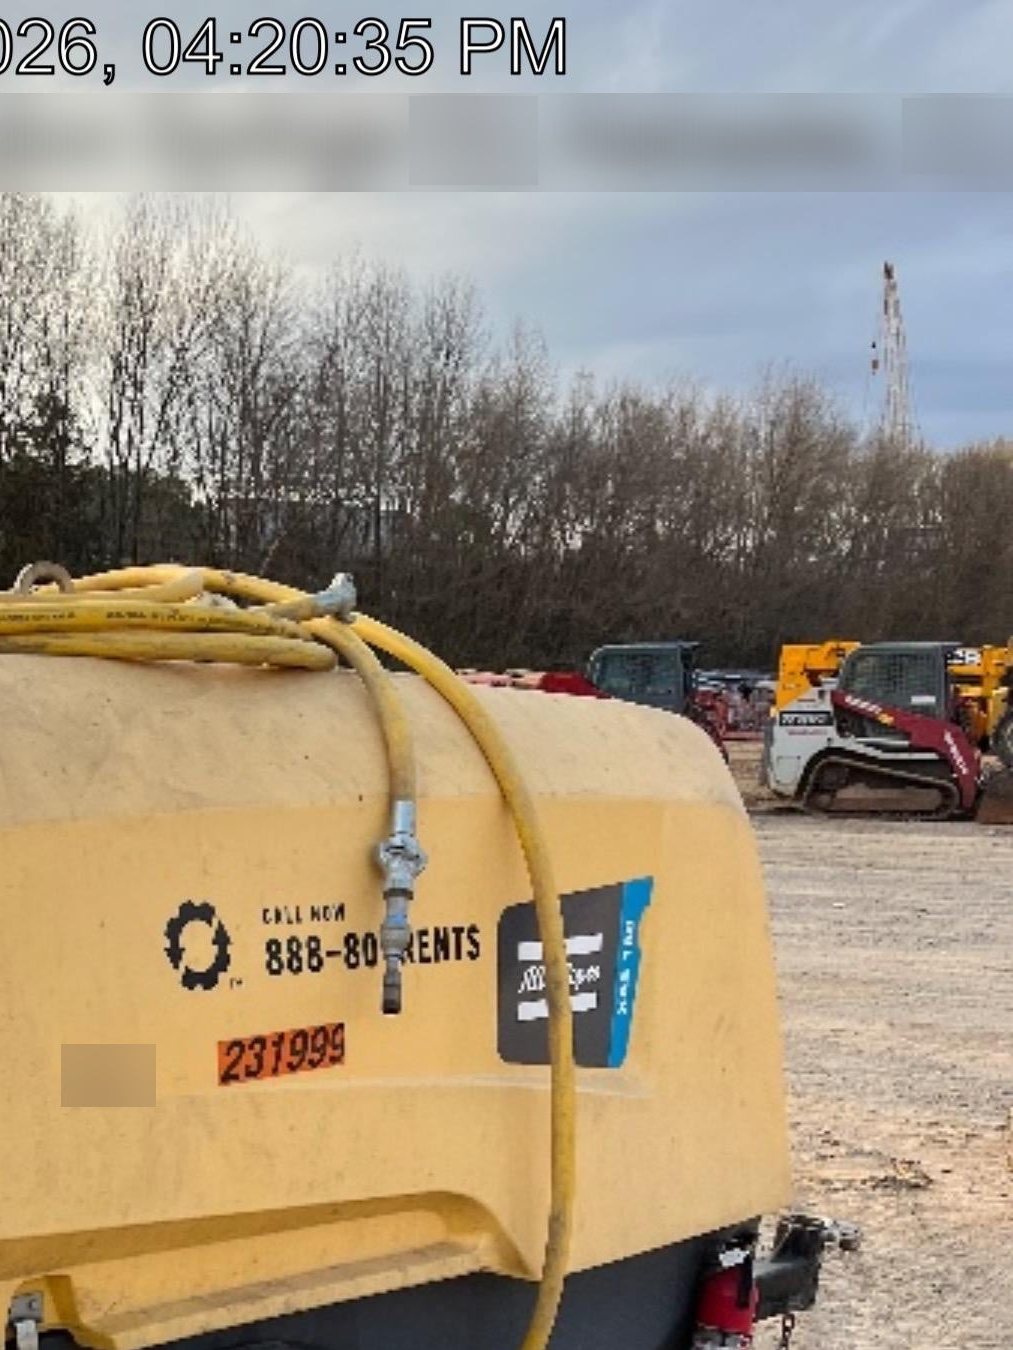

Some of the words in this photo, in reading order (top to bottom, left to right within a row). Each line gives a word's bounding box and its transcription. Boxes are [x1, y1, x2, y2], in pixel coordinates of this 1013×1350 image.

[262, 905, 303, 925] CALL
[310, 903, 346, 922] NOW
[219, 1022, 345, 1084] 231999
